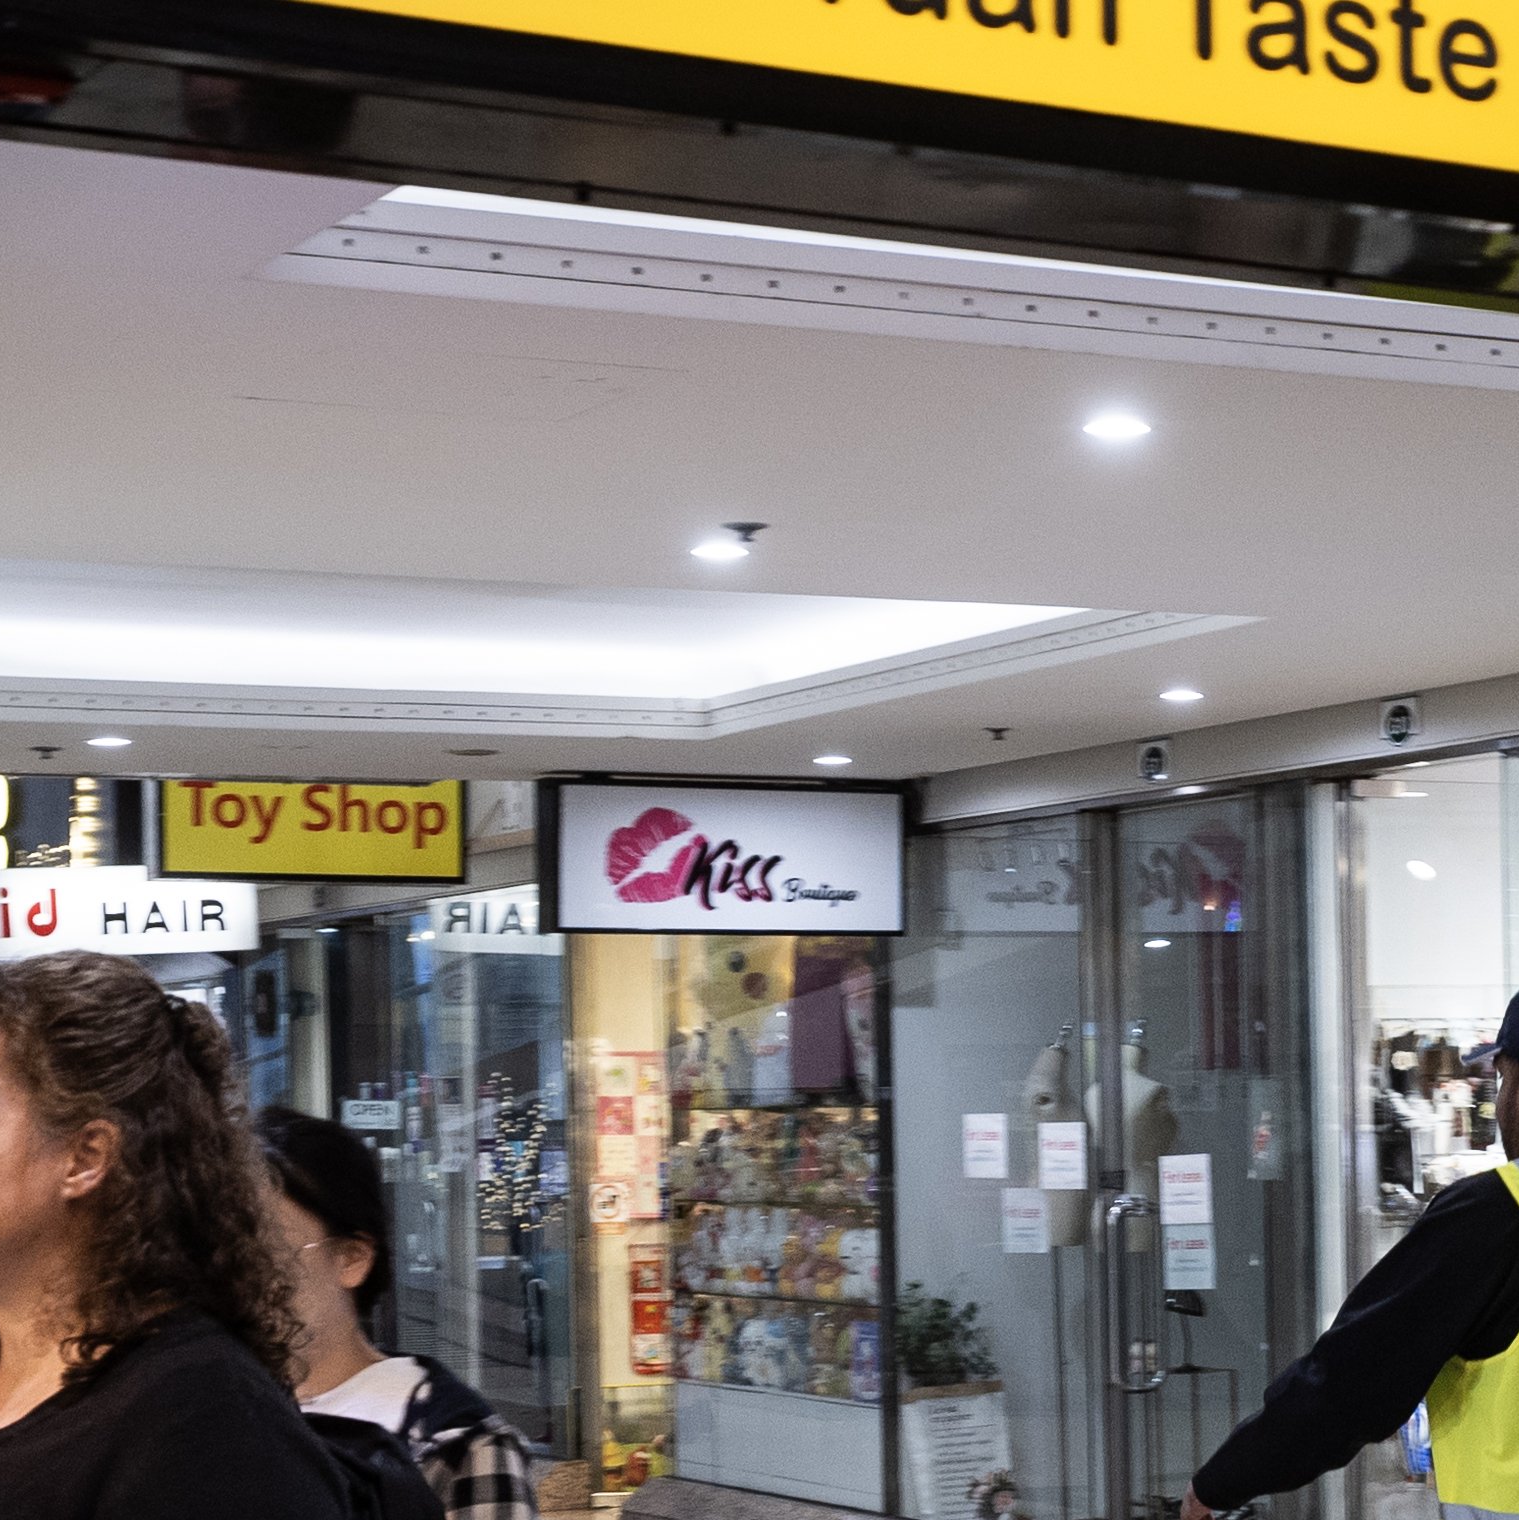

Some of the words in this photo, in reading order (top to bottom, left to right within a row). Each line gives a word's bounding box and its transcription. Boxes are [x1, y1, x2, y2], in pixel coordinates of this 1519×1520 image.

[178, 780, 283, 843] Toy
[300, 783, 449, 849] Shop
[683, 837, 784, 911] Kiss
[102, 898, 231, 936] HAIR
[350, 1102, 394, 1117] OPEN
